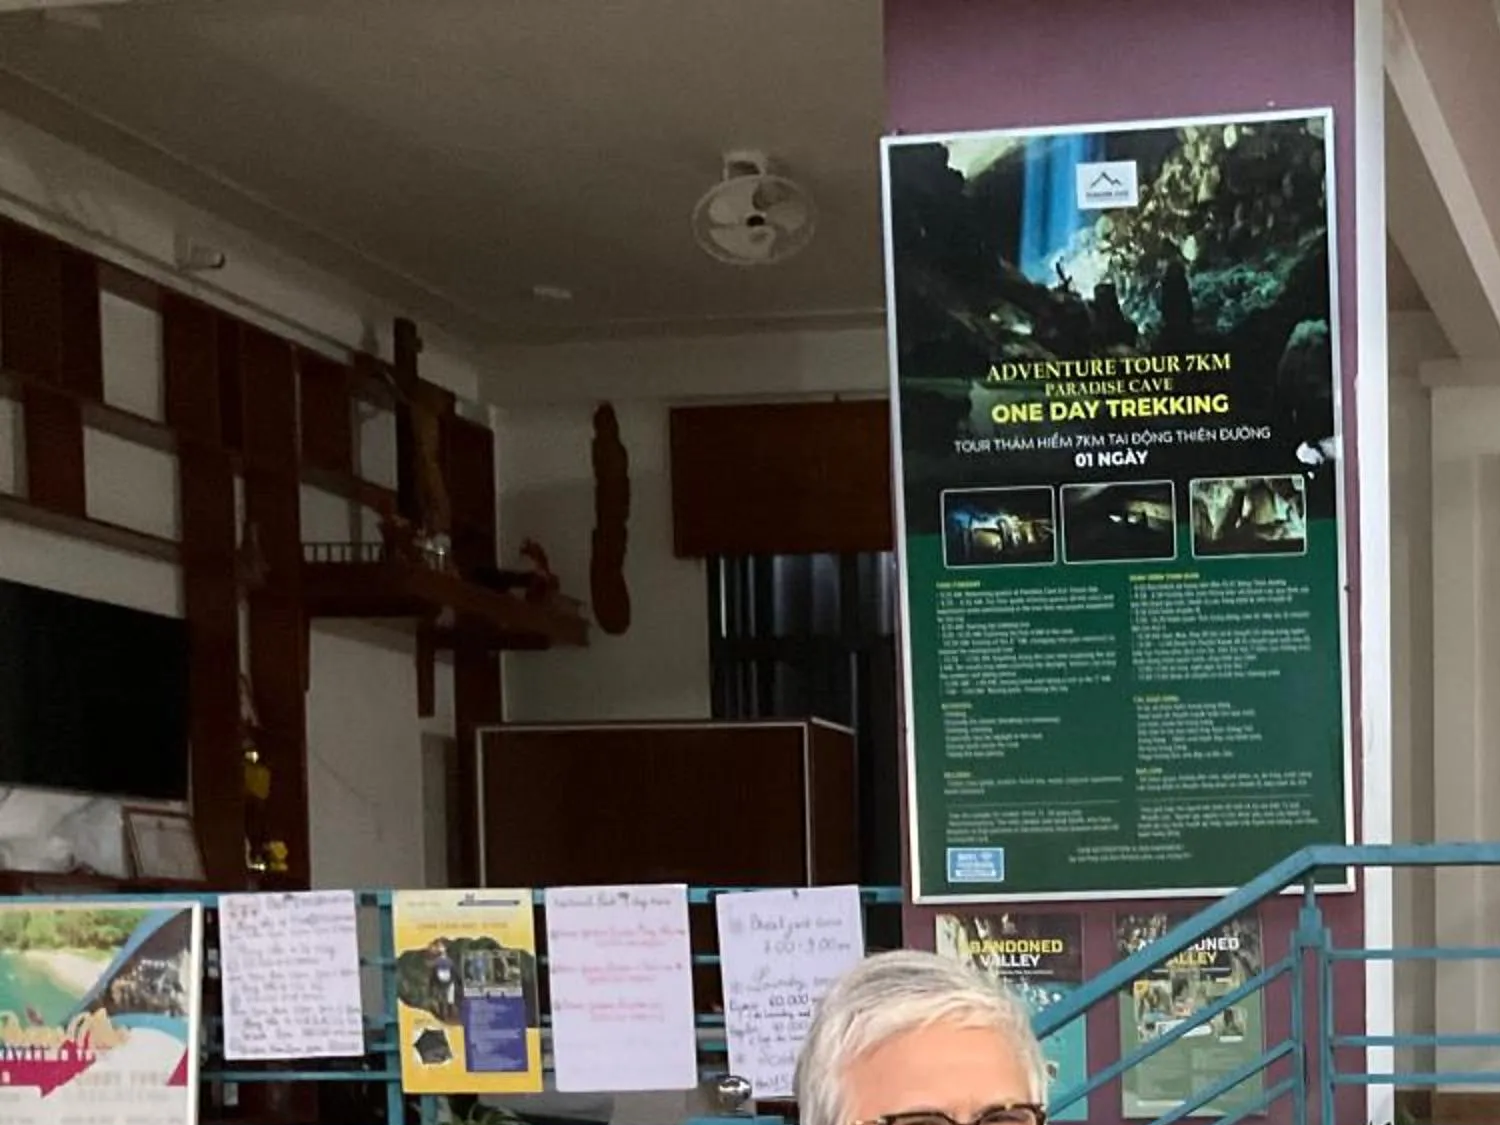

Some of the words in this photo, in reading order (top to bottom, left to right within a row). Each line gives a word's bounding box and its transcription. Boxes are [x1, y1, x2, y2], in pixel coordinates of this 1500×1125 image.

[986, 359, 1117, 382] ADVENTURE
[1121, 355, 1181, 375] TOUR
[1185, 353, 1231, 372] 7KM
[1045, 379, 1126, 397] PARADISE
[1128, 377, 1173, 393] CAVE
[991, 402, 1044, 424] ONE
[1049, 399, 1100, 421] DAY
[1105, 393, 1230, 418] TREKKING
[954, 438, 992, 453] TOUR
[1075, 434, 1105, 448] 7KM
[1074, 451, 1094, 468] 01
[1097, 447, 1149, 467] NGÀY
